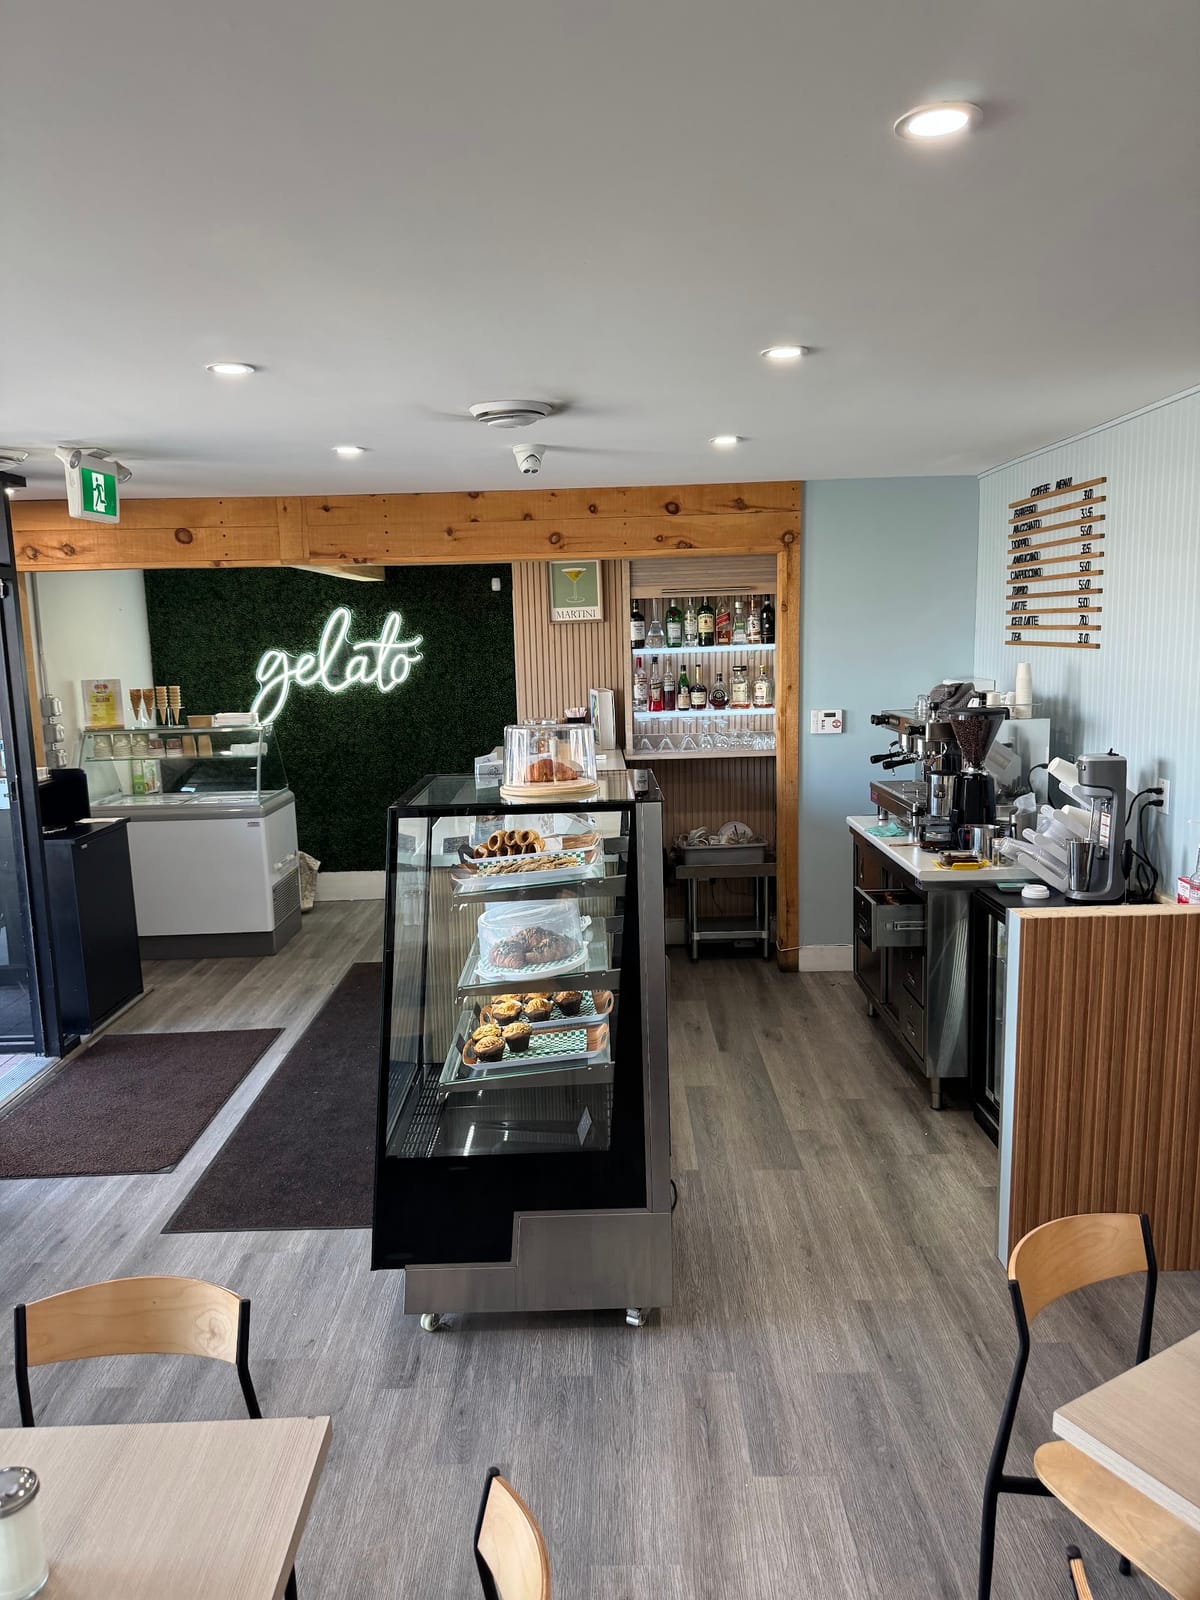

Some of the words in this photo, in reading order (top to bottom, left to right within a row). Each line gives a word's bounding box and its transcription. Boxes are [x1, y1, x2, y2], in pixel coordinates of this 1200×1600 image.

[1011, 600, 1028, 611] LATTE
[556, 609, 597, 619] MARTINI
[1023, 615, 1039, 626] LATTE
[1011, 632, 1021, 641] TEA
[251, 606, 422, 726] gelato
